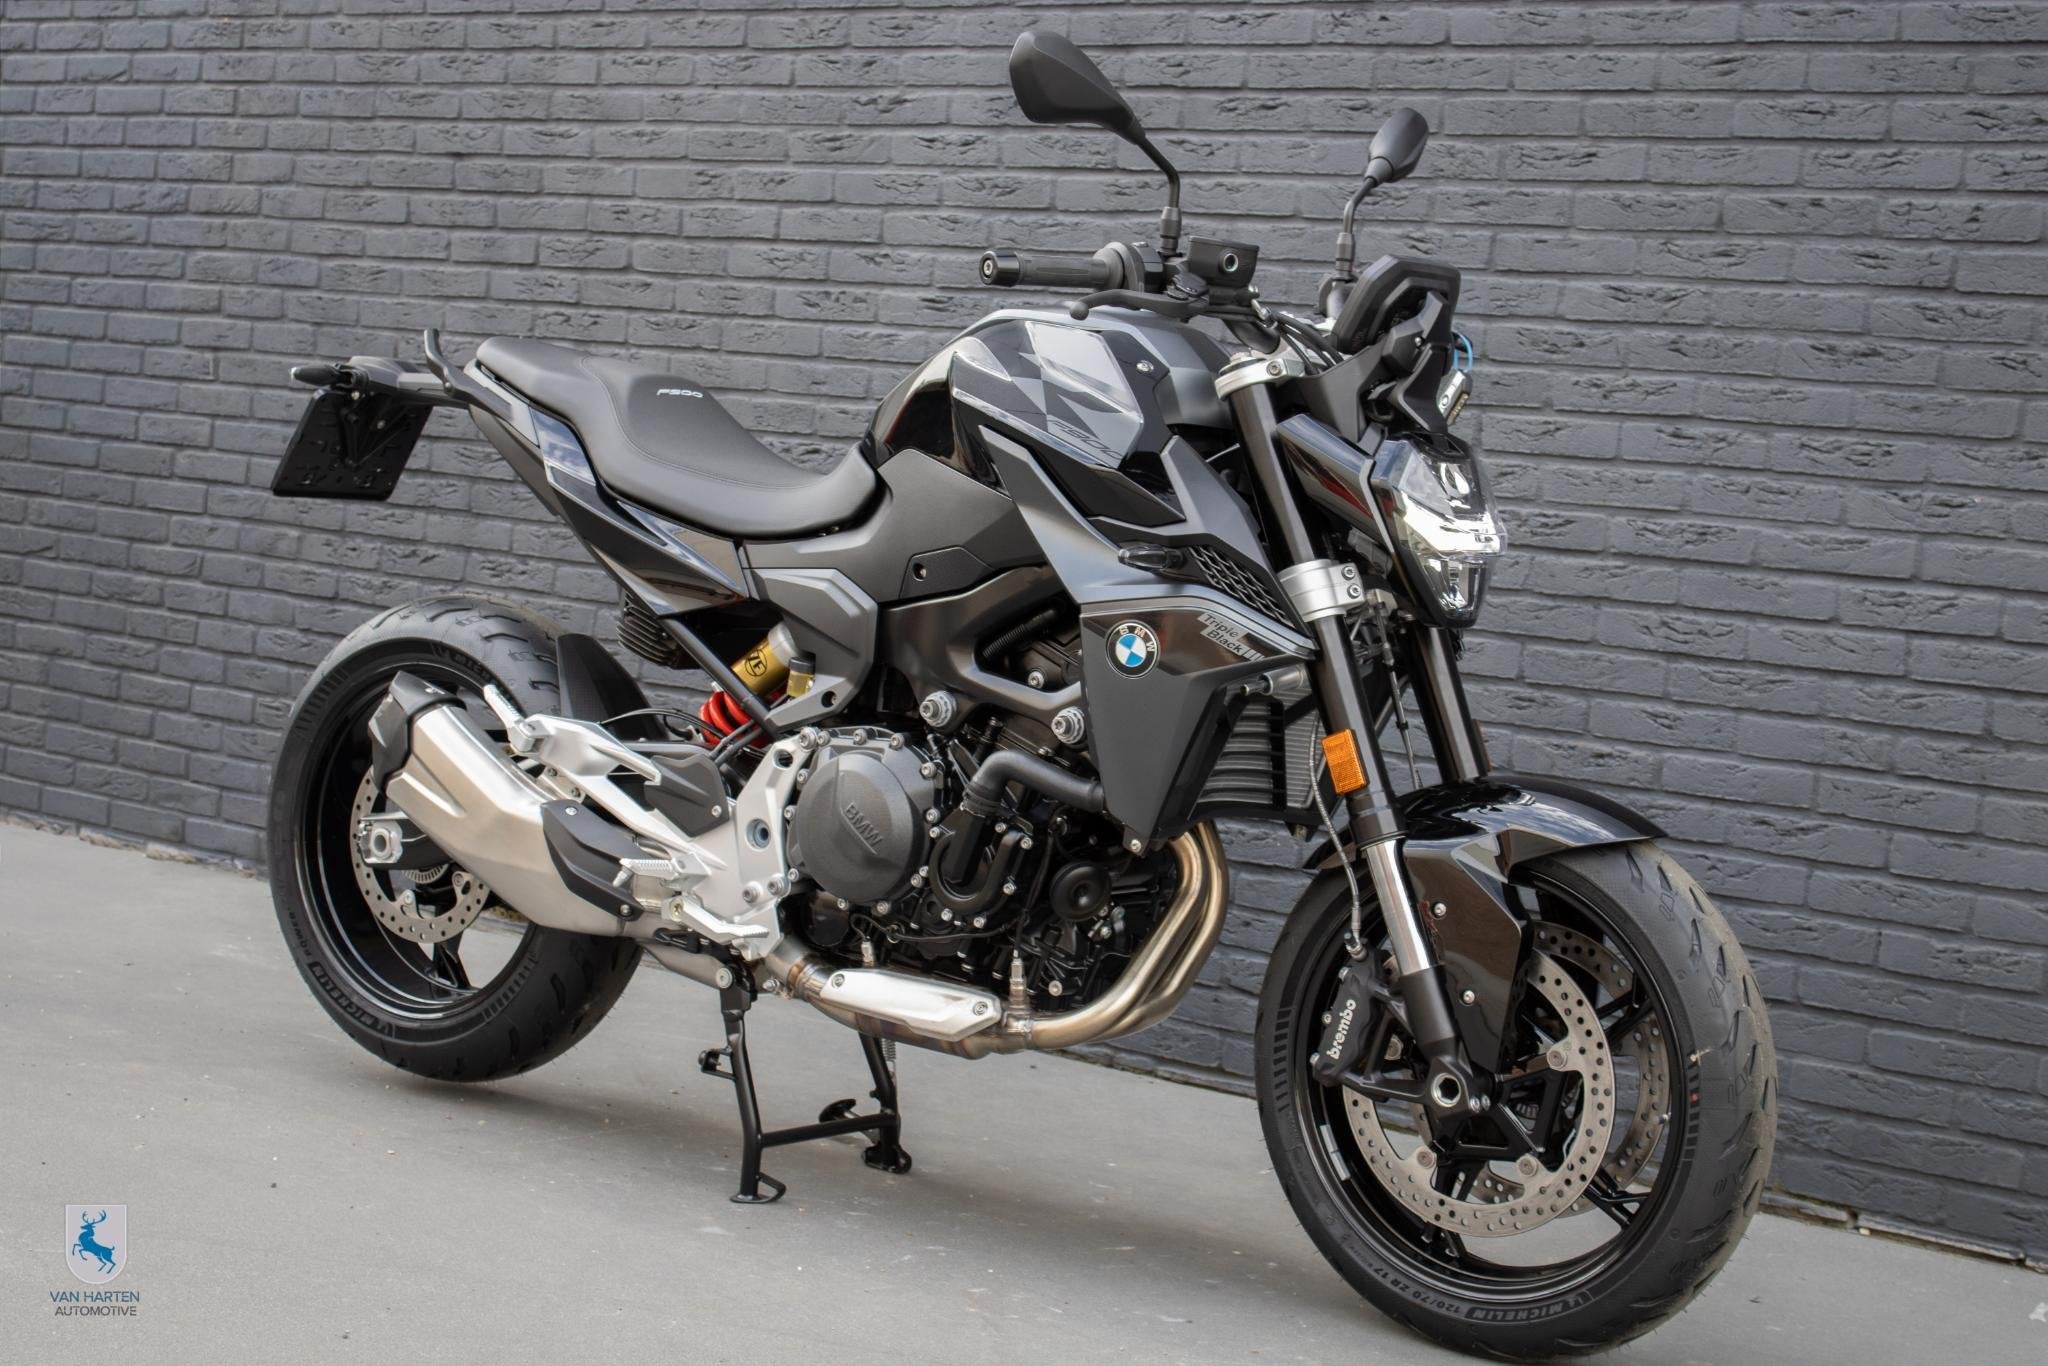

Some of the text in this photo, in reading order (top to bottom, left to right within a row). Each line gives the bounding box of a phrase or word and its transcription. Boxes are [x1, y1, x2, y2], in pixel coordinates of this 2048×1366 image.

[1118, 625, 1155, 652] BMW
[1203, 613, 1239, 638] Triple
[1206, 629, 1244, 654] Black
[844, 801, 884, 848] BMW
[312, 964, 380, 1027] MICHELIN
[1326, 999, 1357, 1060] brembo
[1412, 1290, 1461, 1314] 120/70
[1472, 1300, 1564, 1321] MICHELIN
